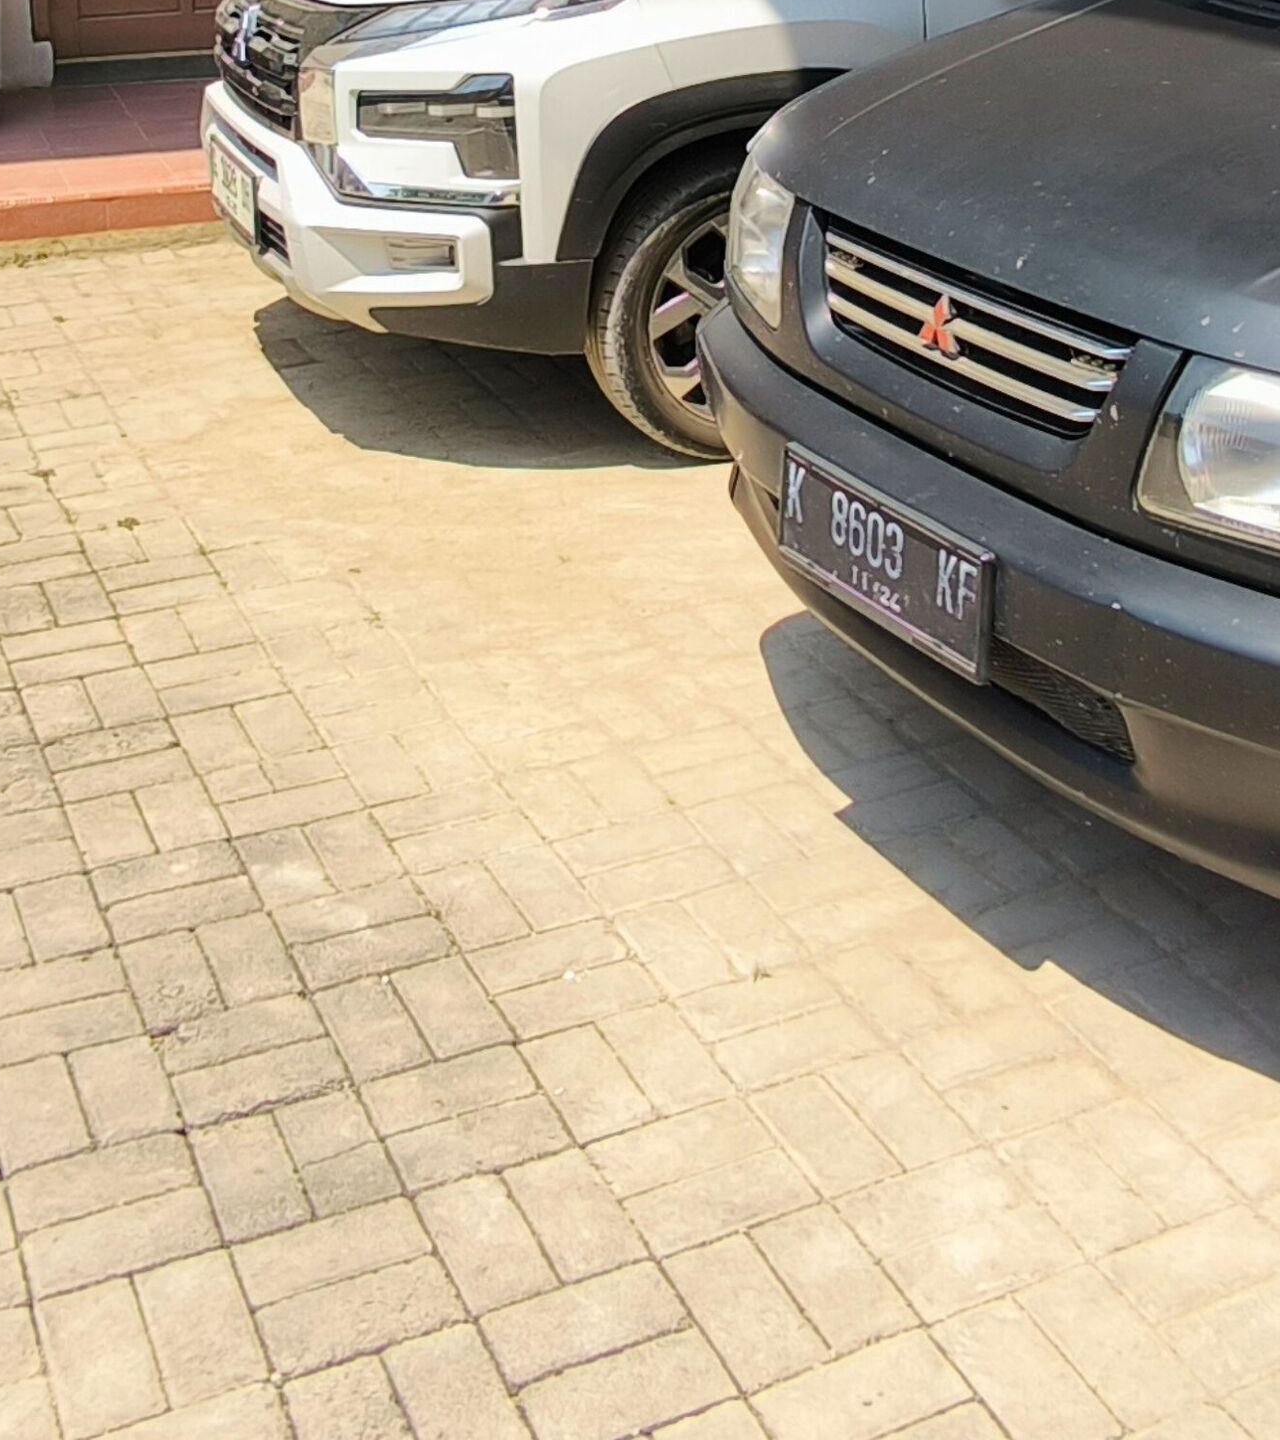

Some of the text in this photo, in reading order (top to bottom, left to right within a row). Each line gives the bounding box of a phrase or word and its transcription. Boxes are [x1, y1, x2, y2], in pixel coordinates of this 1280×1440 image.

[785, 460, 978, 620] K 8603 KF
